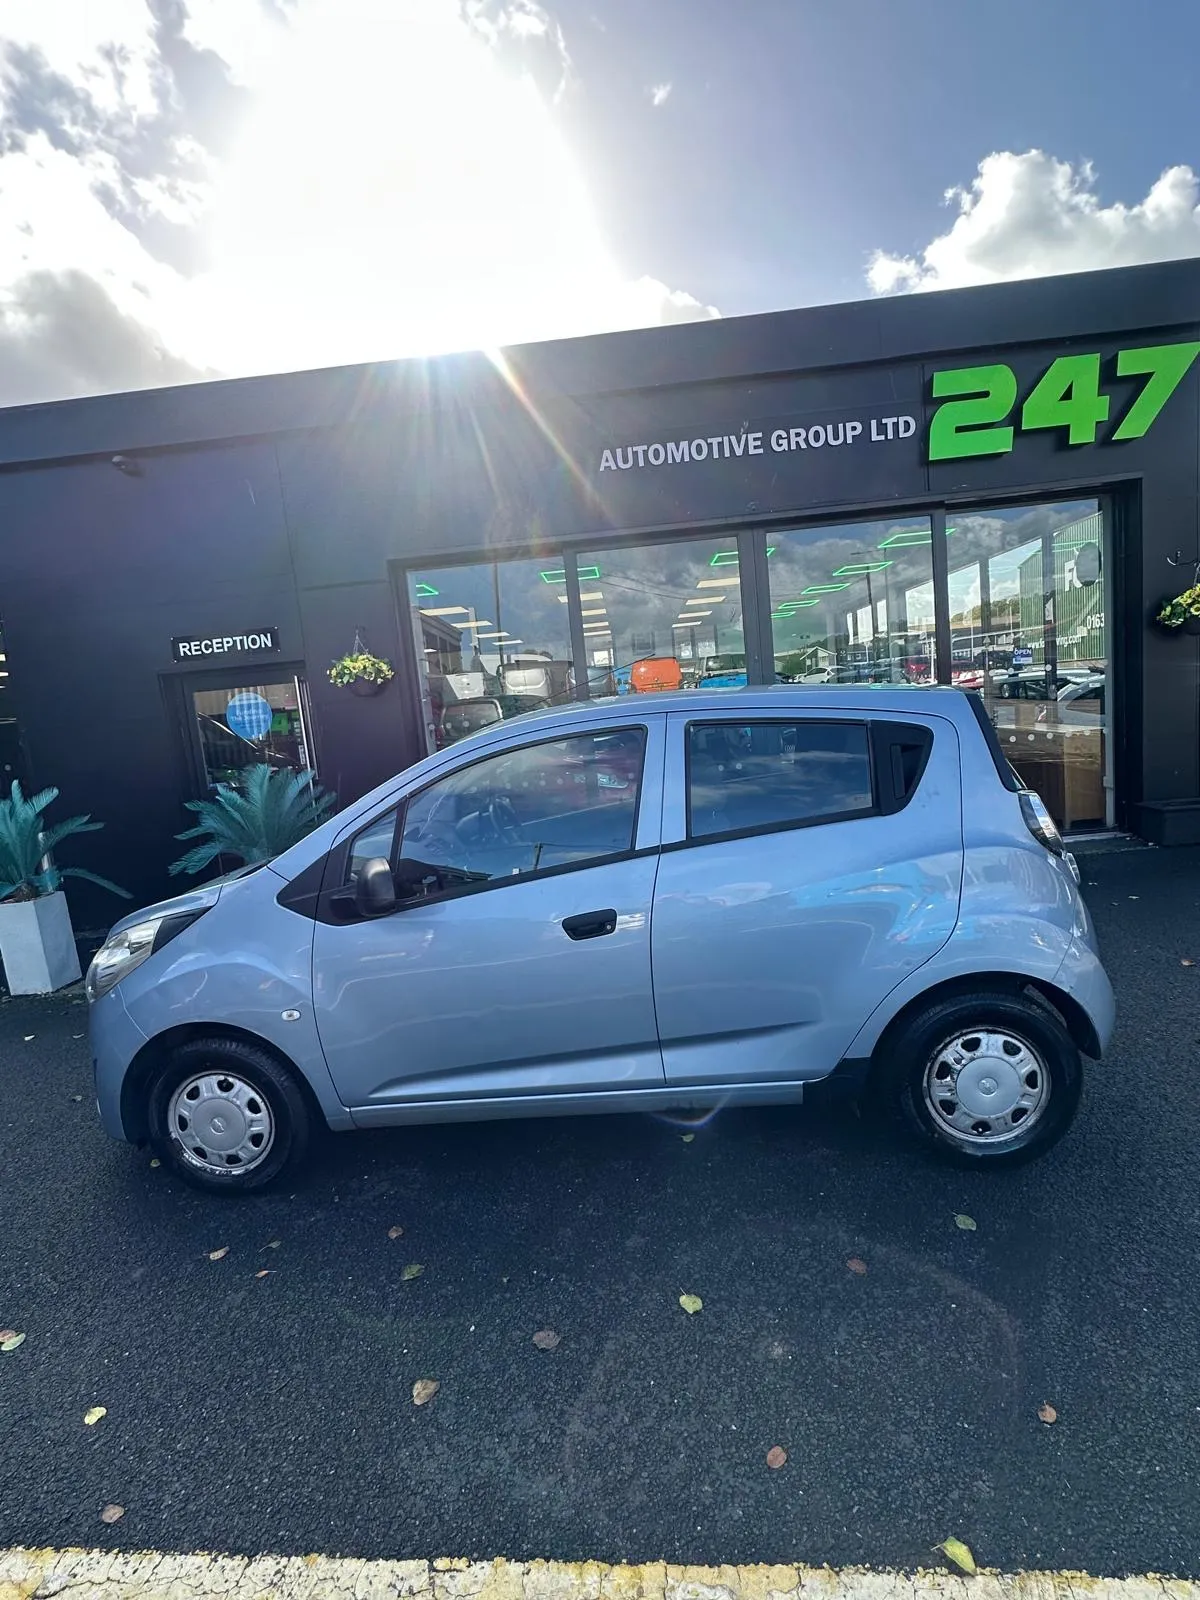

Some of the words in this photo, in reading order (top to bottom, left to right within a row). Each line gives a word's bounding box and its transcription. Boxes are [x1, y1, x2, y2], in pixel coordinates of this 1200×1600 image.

[929, 341, 1200, 460] 247
[600, 432, 764, 472] AUTOMOTIVE
[770, 421, 863, 452] GROUP
[870, 415, 917, 442] LTD
[178, 633, 272, 656] RECEPTION
